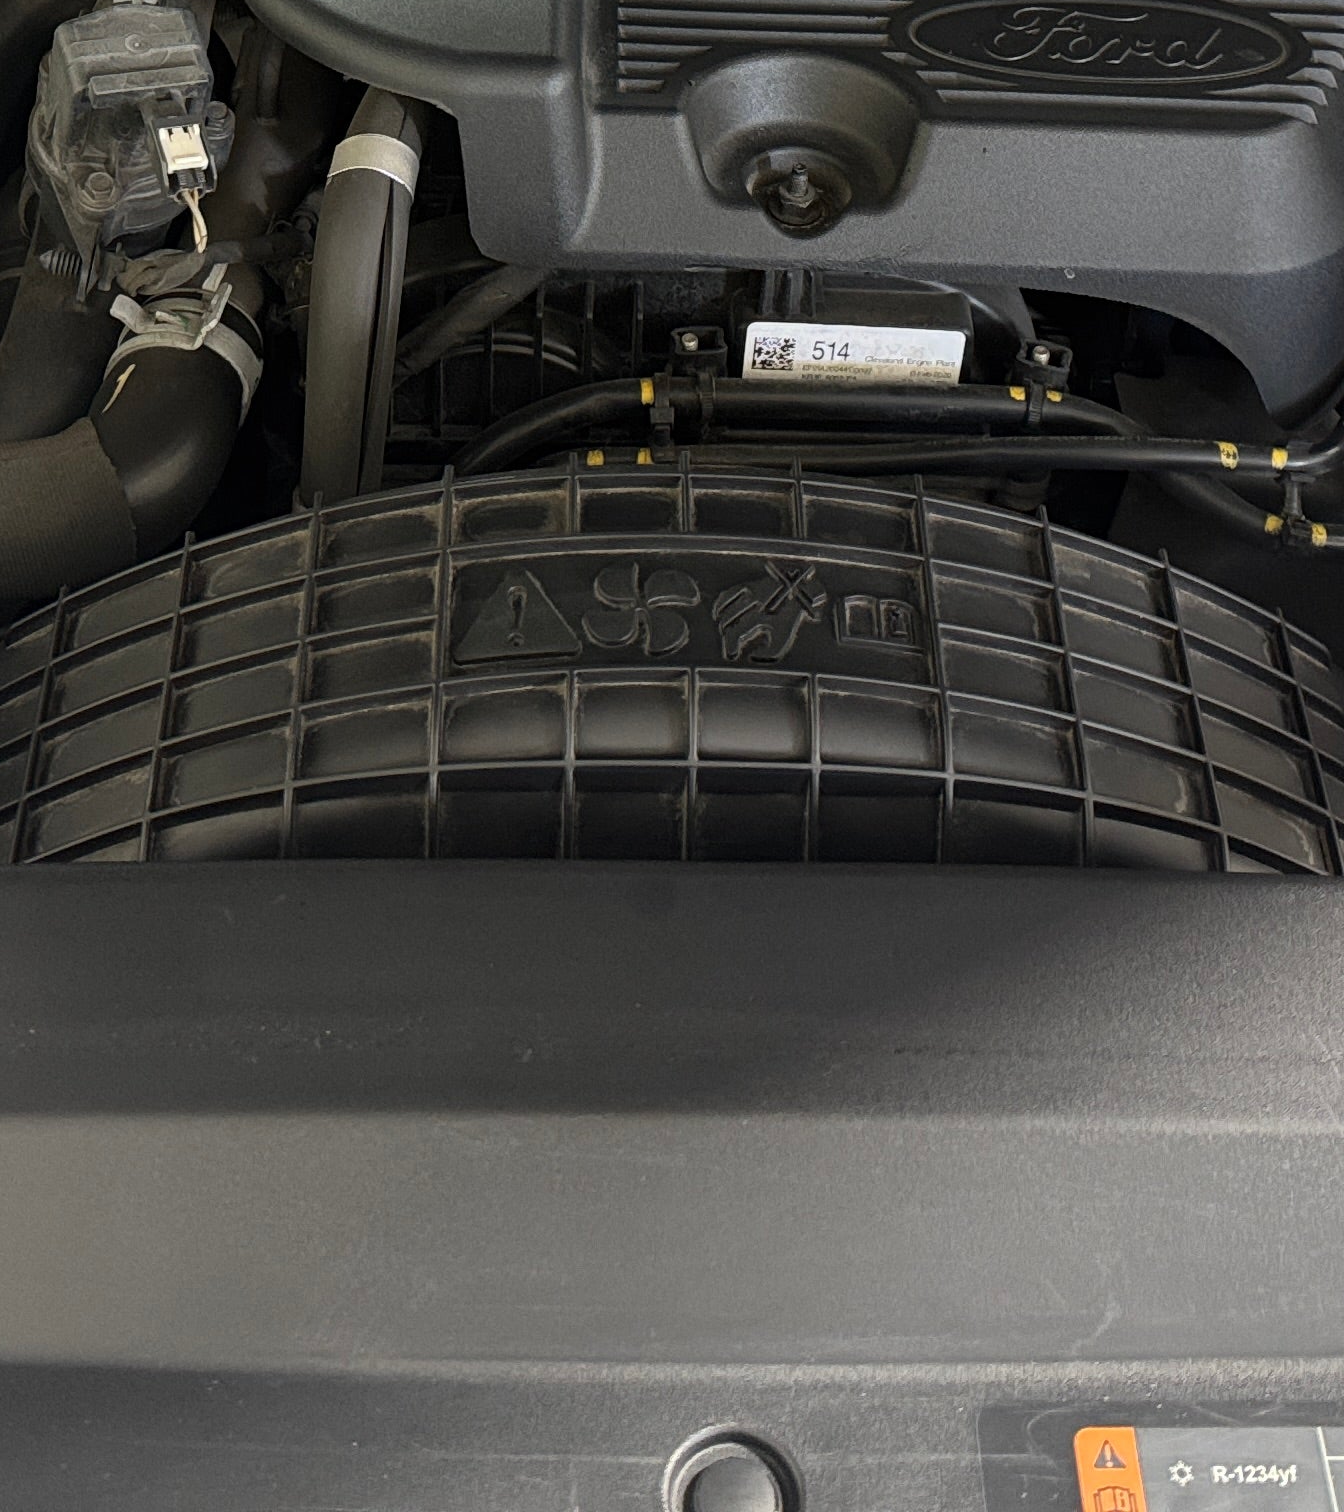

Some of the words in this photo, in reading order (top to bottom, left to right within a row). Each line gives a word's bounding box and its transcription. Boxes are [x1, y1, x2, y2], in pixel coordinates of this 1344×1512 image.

[983, 6, 1225, 71] Ford
[811, 340, 851, 361] 514
[1211, 1463, 1297, 1487] R-1234yf
